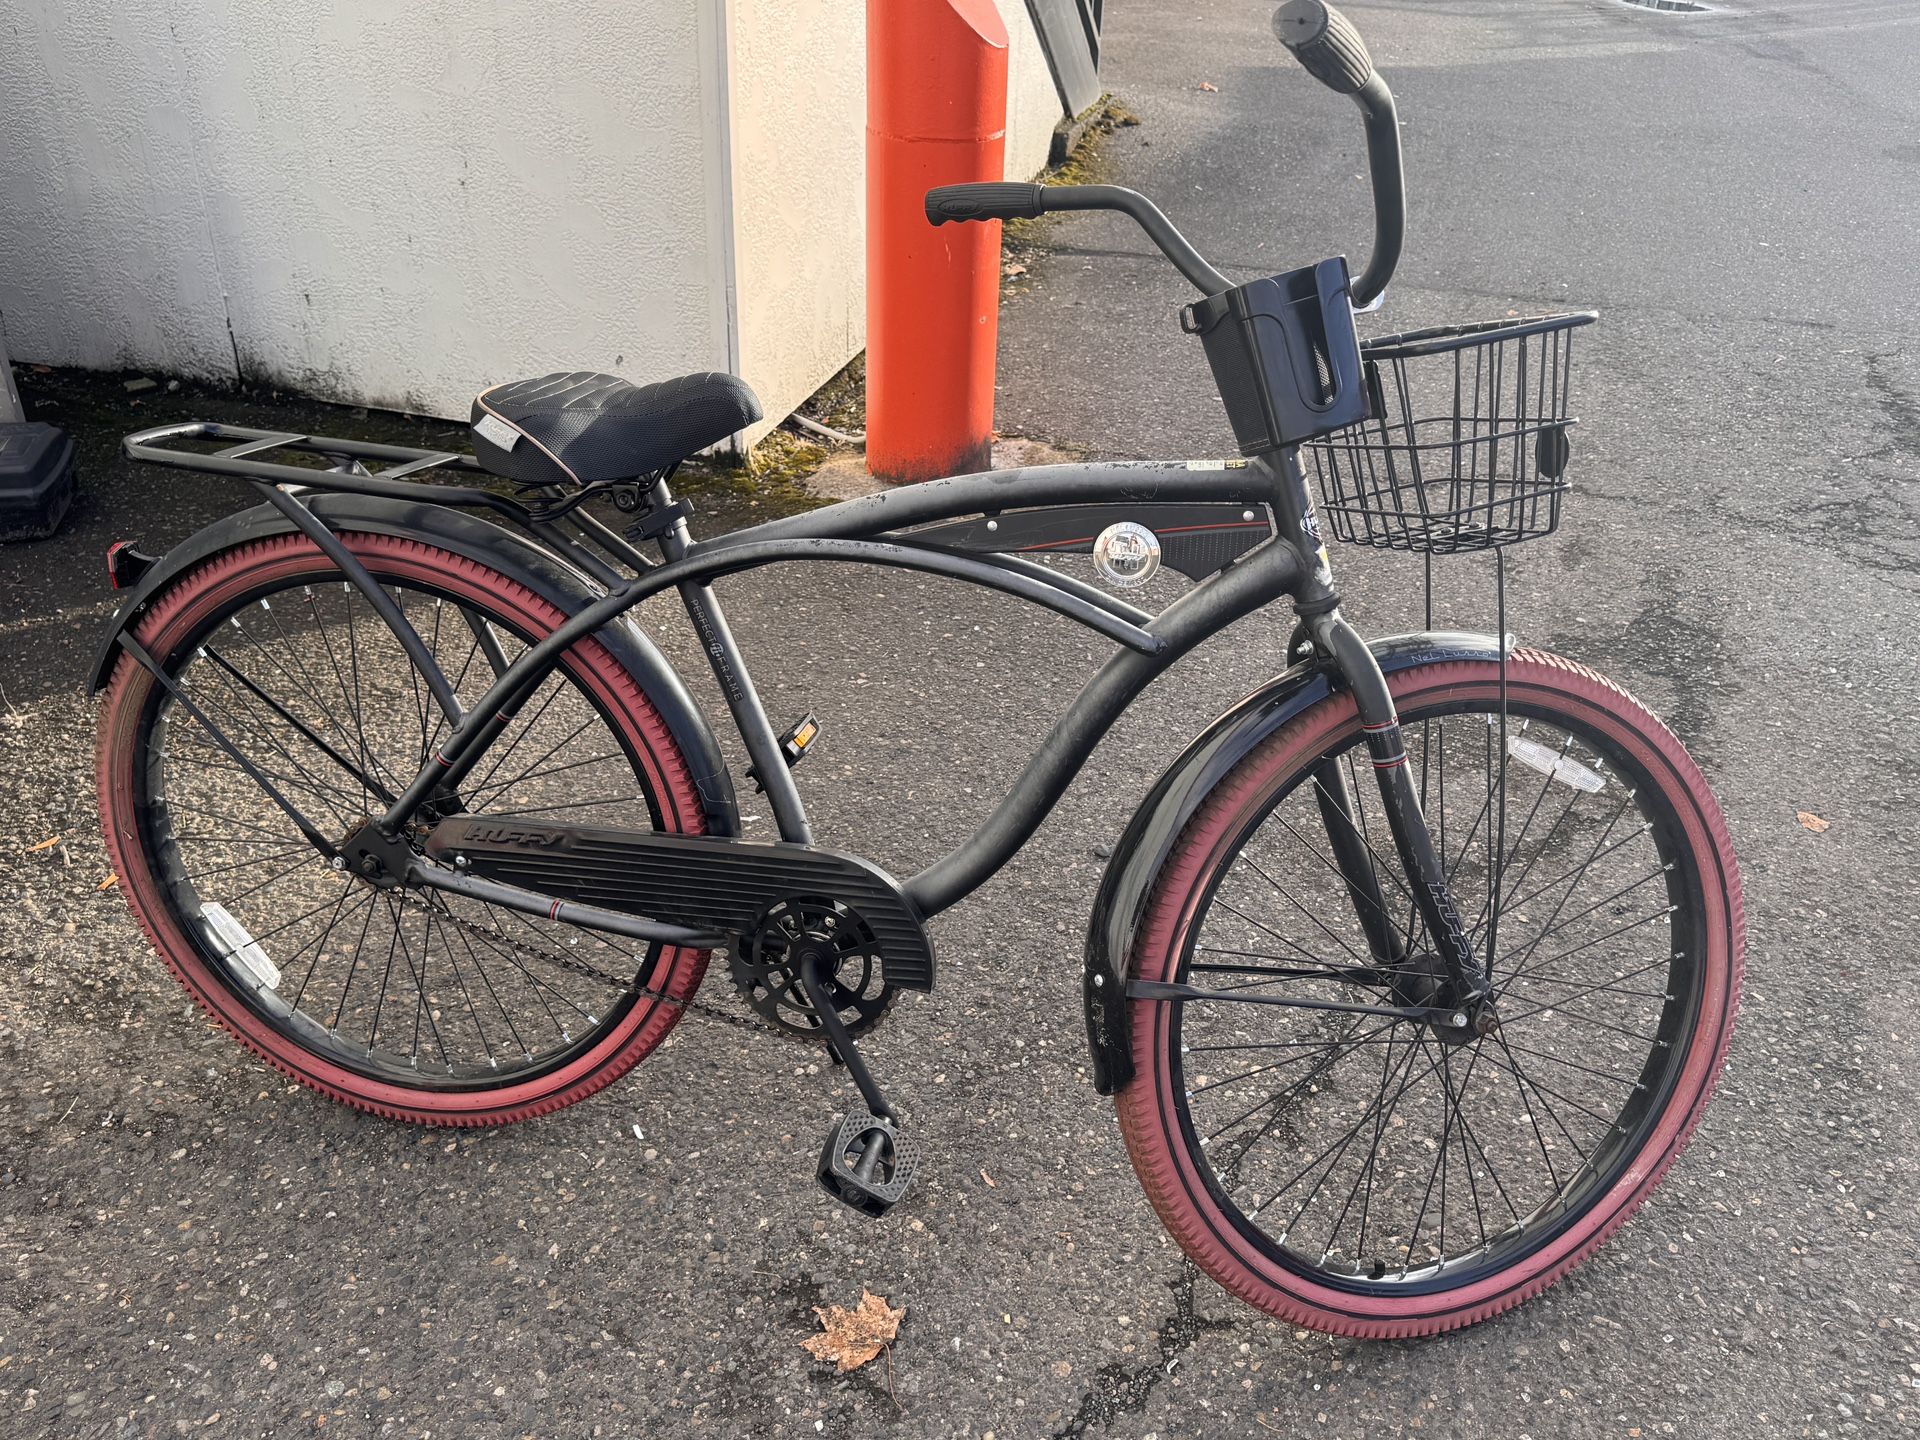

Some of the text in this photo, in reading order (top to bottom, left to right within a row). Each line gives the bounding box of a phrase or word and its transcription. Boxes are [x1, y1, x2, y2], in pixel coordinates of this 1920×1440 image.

[690, 599, 718, 643] PERFECT
[718, 656, 744, 702] FRAME
[463, 823, 567, 847] HUFFY
[1426, 882, 1484, 978] HUFFY
